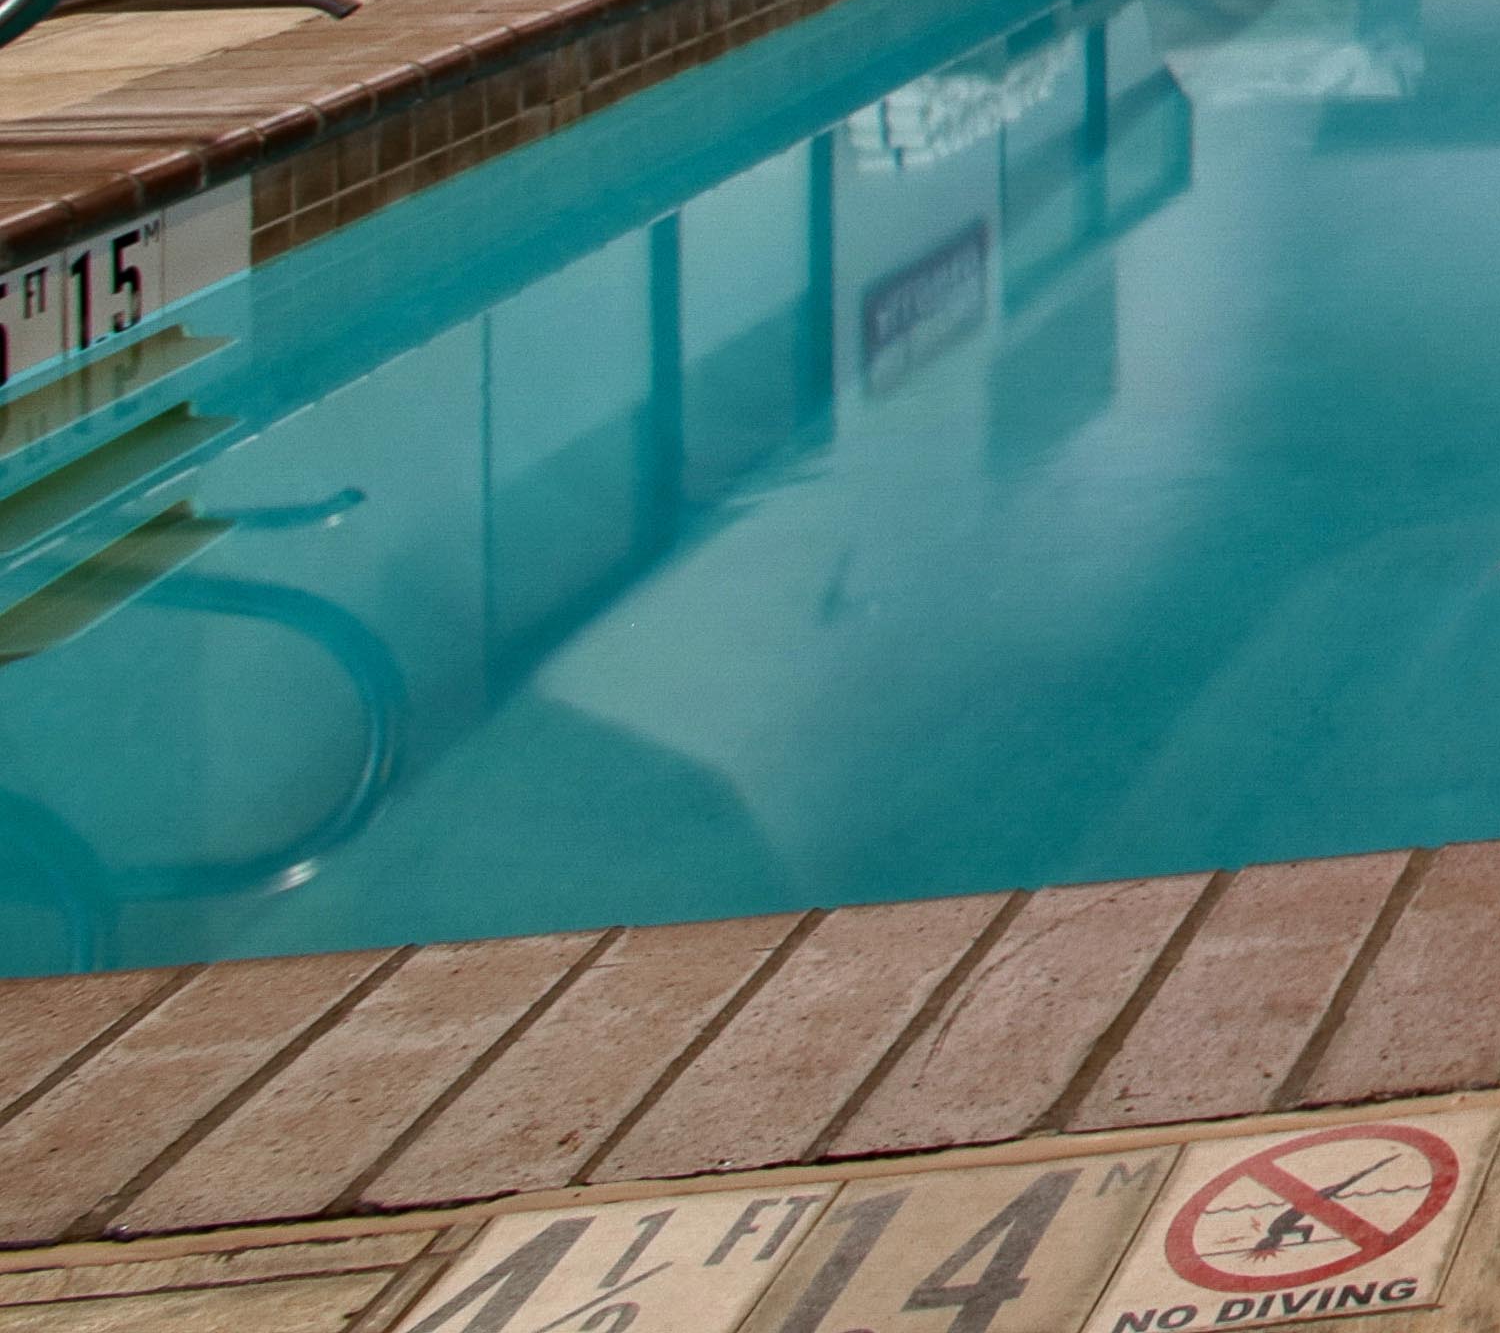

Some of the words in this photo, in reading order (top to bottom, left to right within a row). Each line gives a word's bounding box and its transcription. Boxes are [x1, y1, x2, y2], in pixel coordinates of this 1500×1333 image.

[24, 266, 47, 319] FT
[144, 219, 160, 245] M
[704, 1194, 830, 1267] FT
[1096, 1158, 1162, 1197] M
[1111, 1304, 1199, 1333] NO
[1215, 1277, 1420, 1324] DIVING
